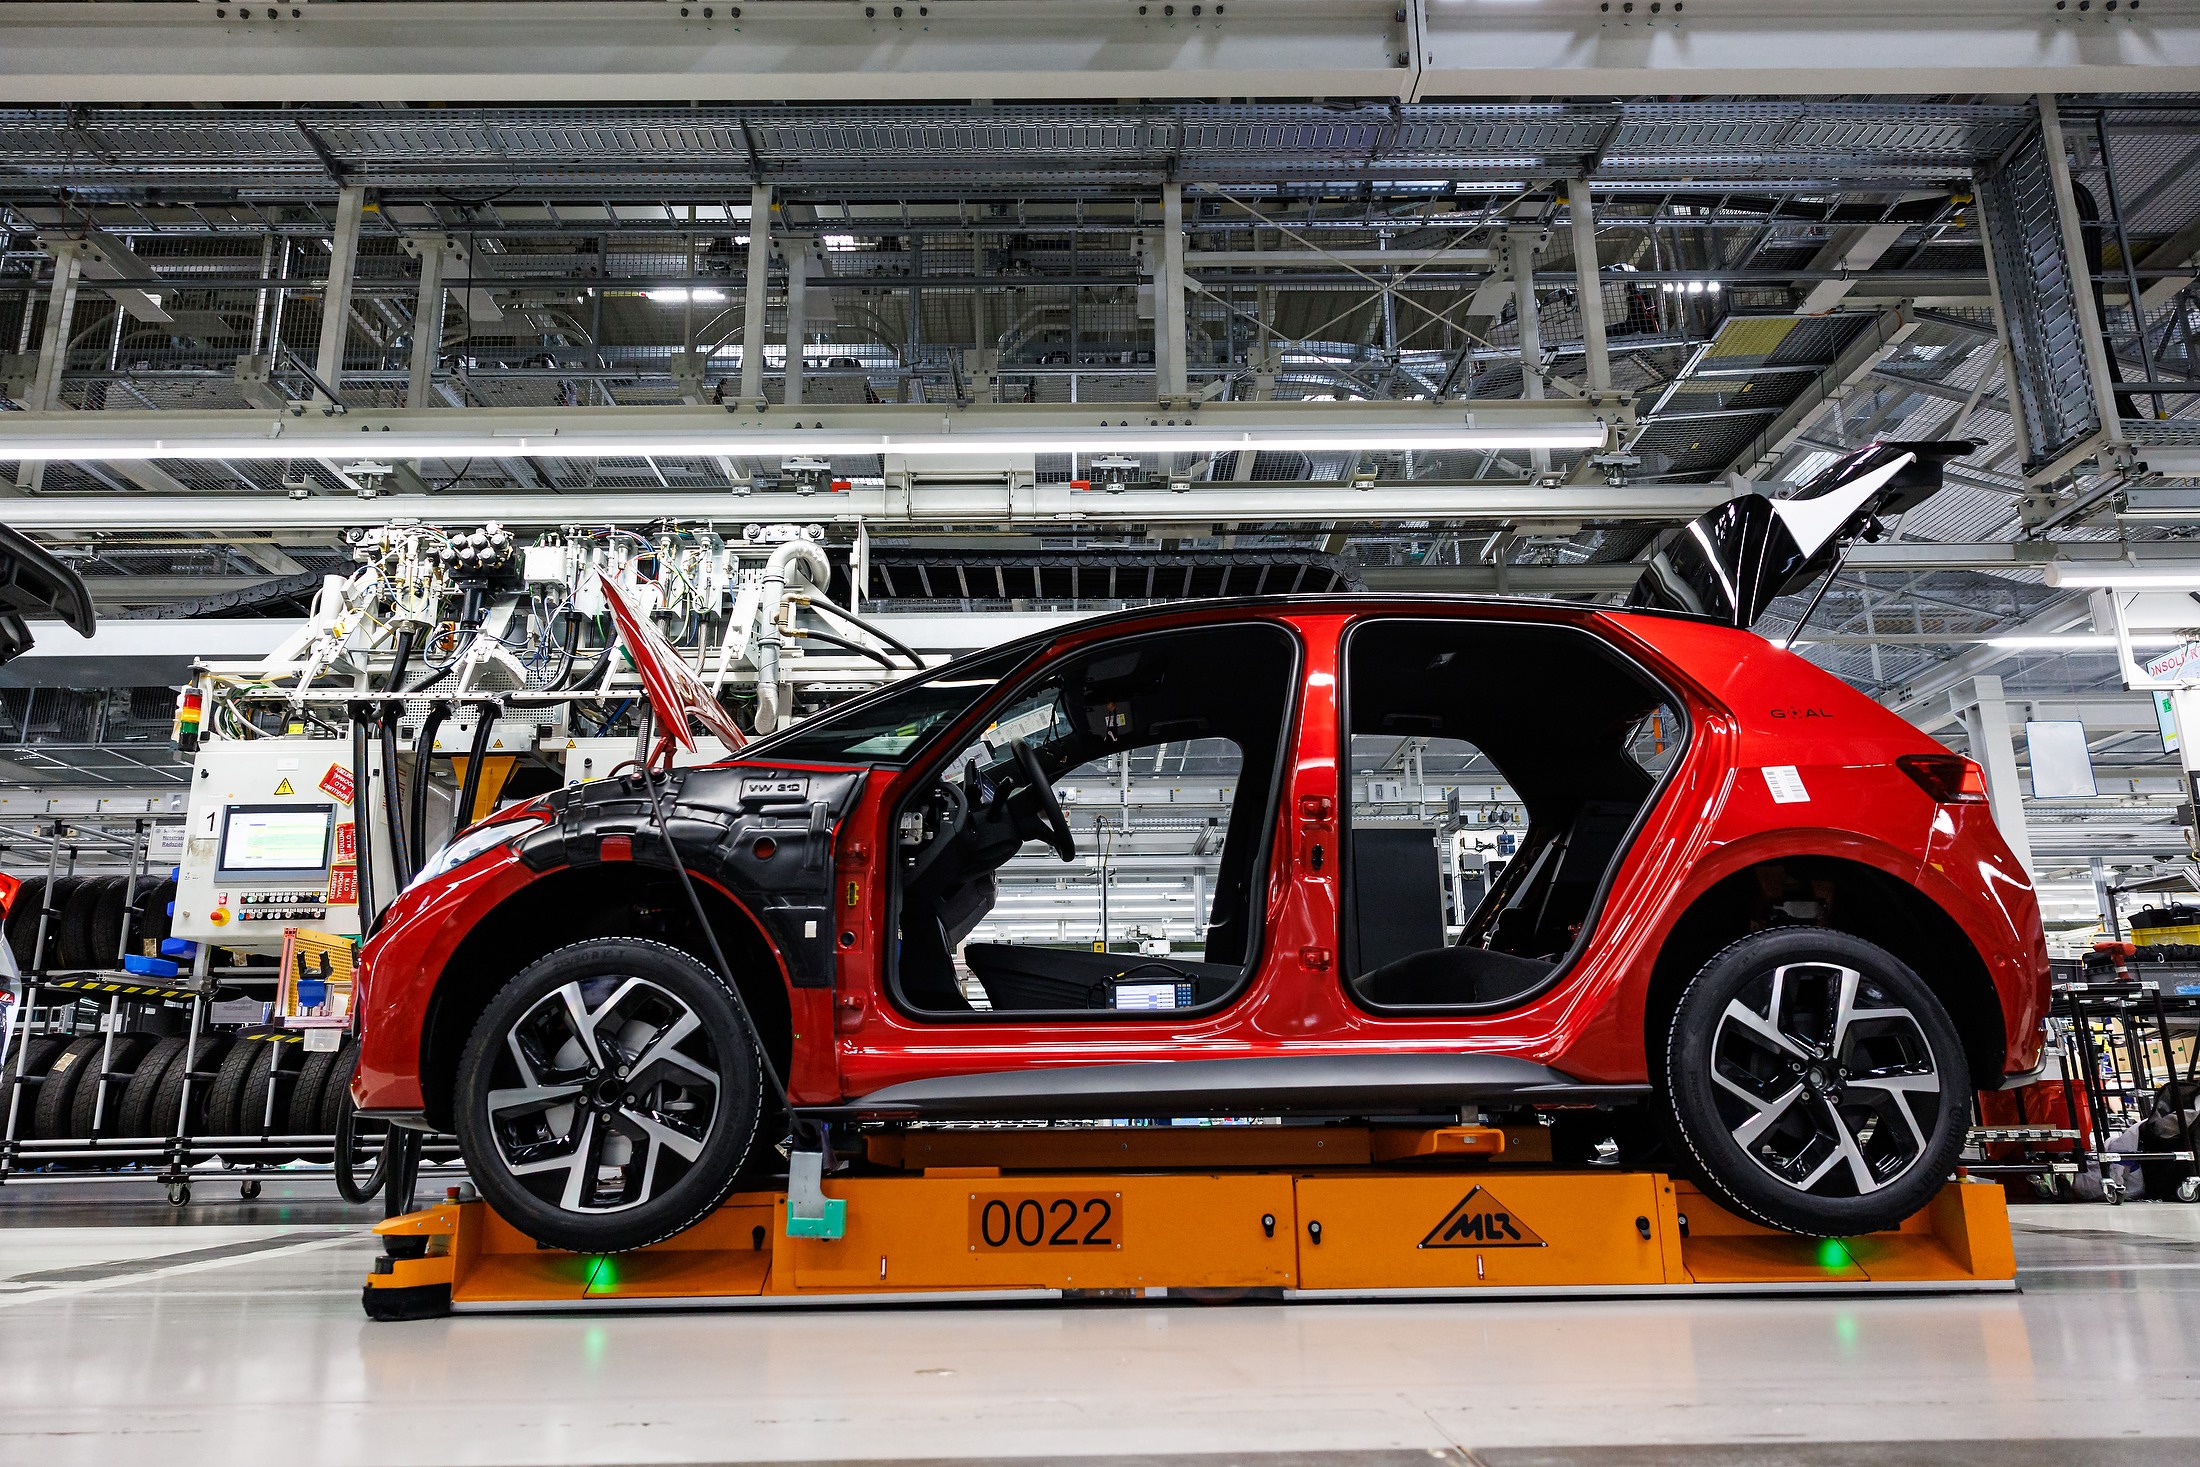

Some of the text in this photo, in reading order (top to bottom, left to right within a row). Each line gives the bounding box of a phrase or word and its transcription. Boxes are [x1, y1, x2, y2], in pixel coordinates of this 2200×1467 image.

[749, 784, 773, 792] VW
[206, 811, 216, 832] 1
[981, 1198, 1112, 1247] 0022
